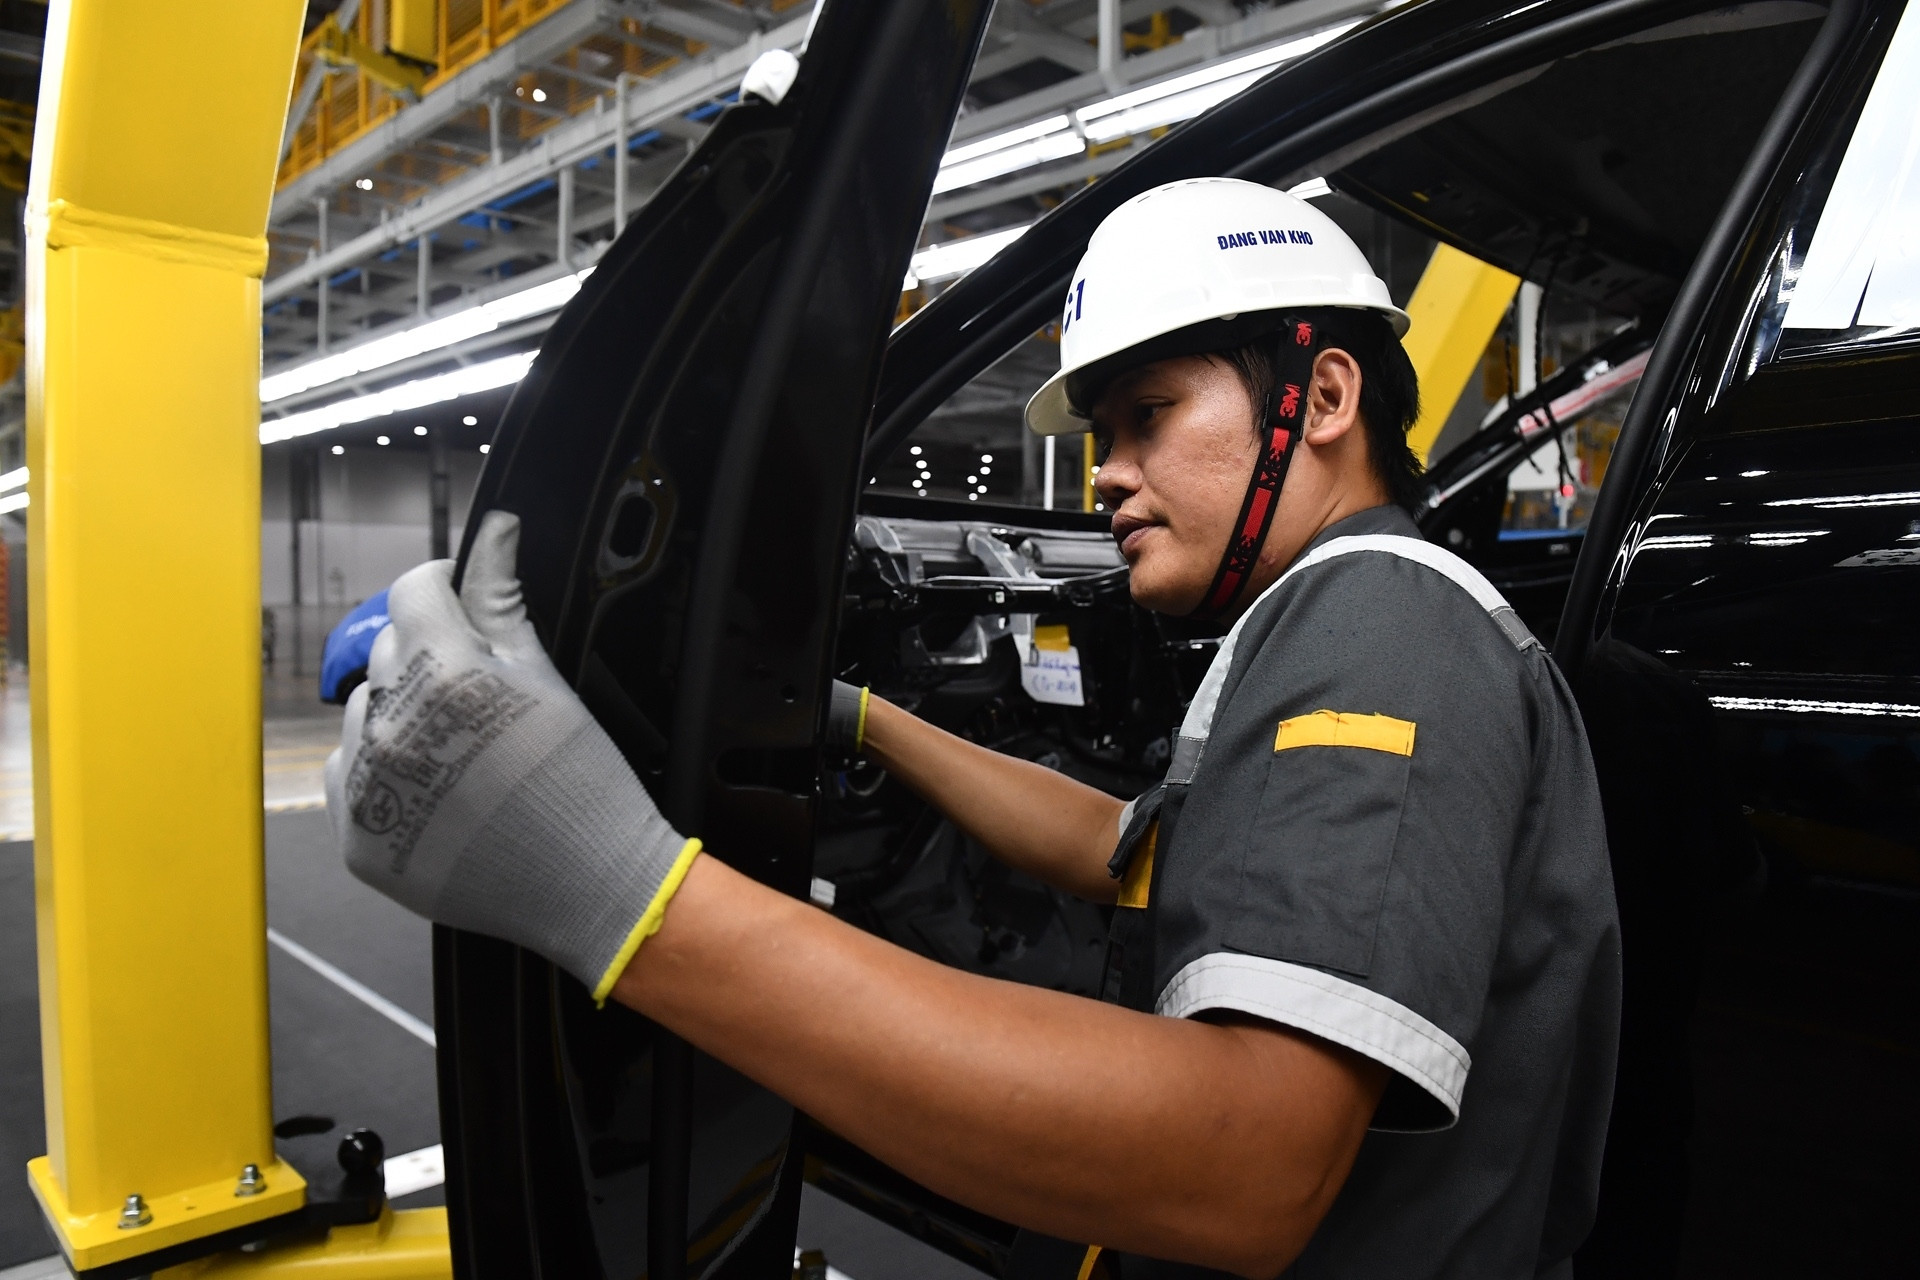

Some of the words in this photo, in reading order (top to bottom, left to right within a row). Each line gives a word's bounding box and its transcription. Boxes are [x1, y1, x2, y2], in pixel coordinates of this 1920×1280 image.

[1217, 231, 1258, 250] ĐANG
[1258, 230, 1287, 244] VAN
[1287, 230, 1313, 245] KHO
[1279, 383, 1300, 418] 3M
